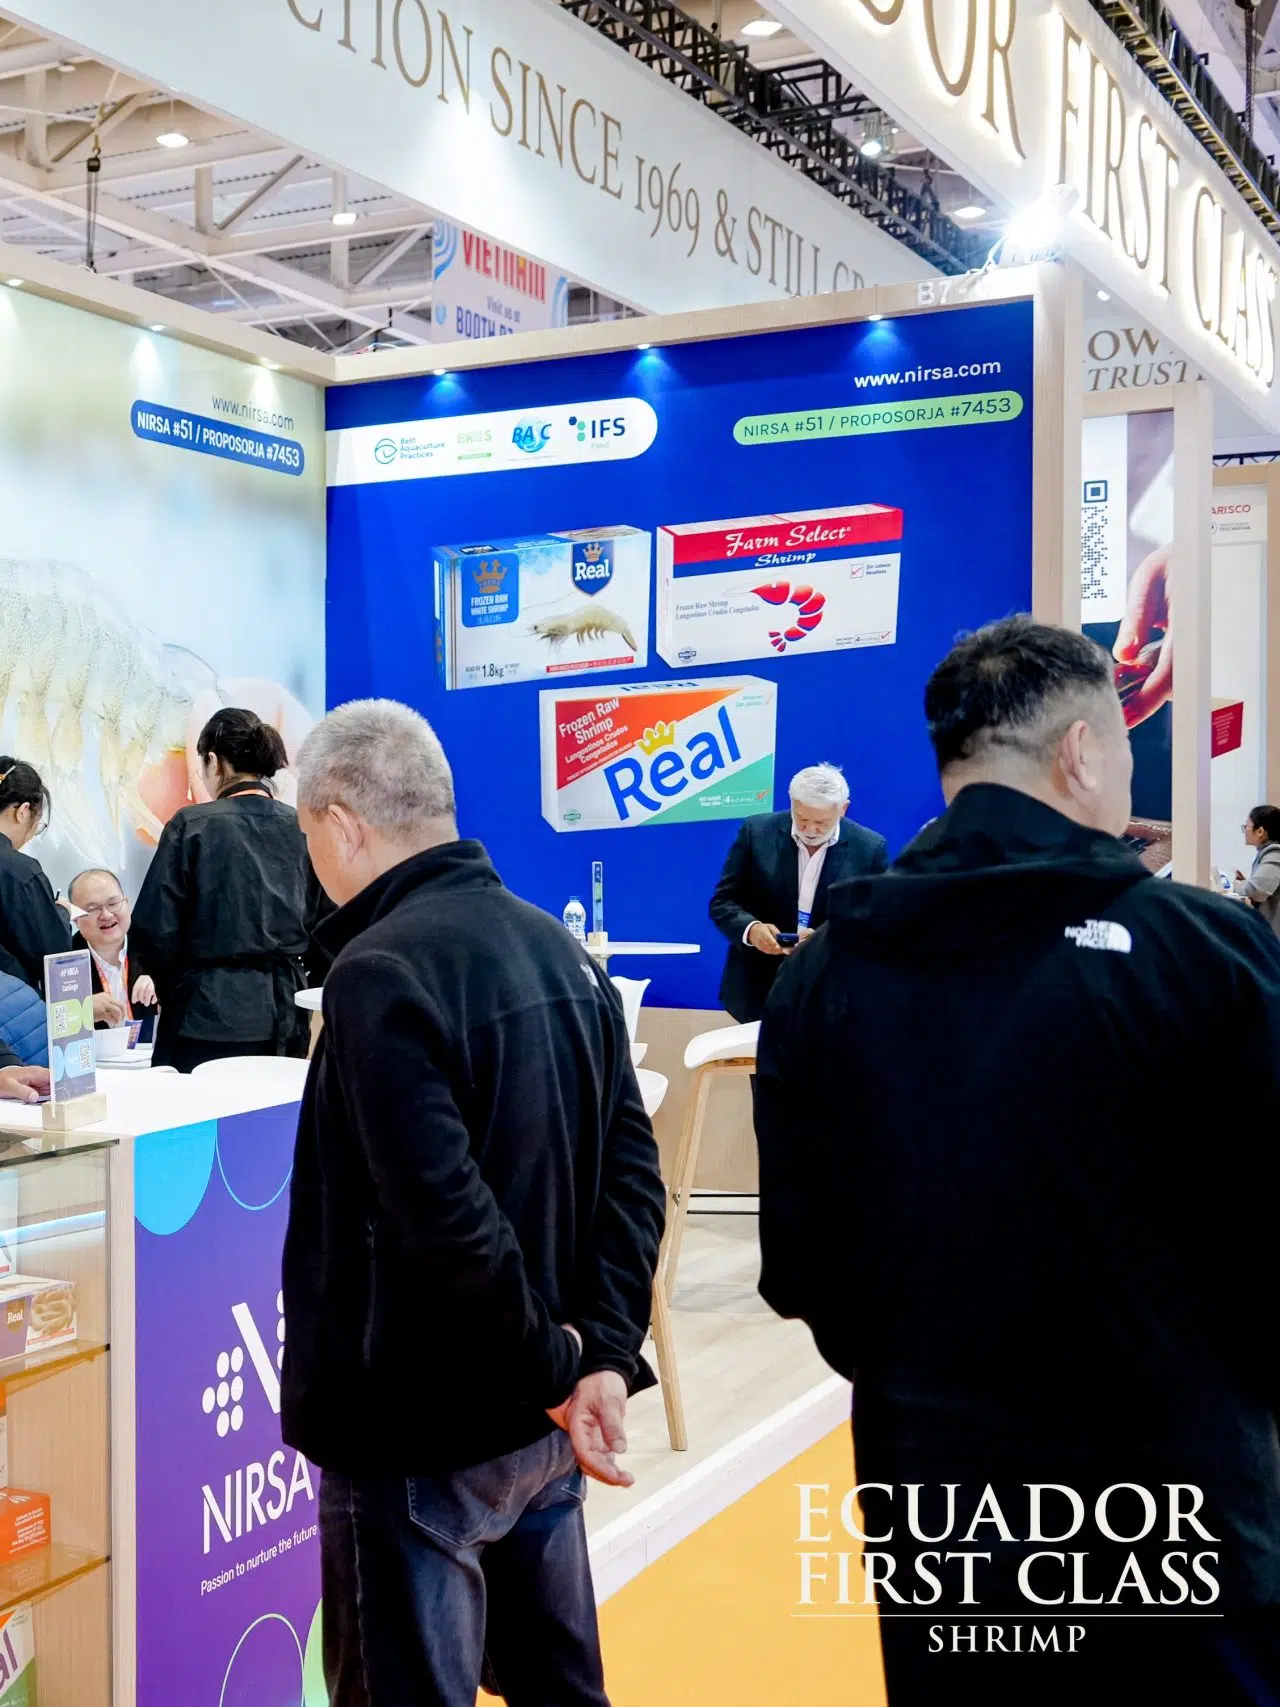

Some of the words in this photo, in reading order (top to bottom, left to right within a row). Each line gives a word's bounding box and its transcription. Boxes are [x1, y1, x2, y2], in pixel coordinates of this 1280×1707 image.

[490, 47, 624, 200] SINCE
[634, 155, 700, 258] 1969
[713, 188, 738, 265] &
[860, 0, 1026, 159] OR
[1053, 12, 1180, 294] FIRST
[854, 361, 1001, 388] www.nirsa.com
[1088, 360, 1207, 391] TRUST
[211, 395, 294, 431] www.nirsa.com
[591, 417, 626, 438] IFS
[744, 420, 789, 437] NIRSA
[794, 416, 823, 432] #51
[828, 415, 835, 431] /
[840, 407, 945, 428] PROPOSORJA
[950, 398, 1012, 417] #7453
[137, 411, 170, 435] NIRSA
[172, 419, 193, 440] #51
[195, 424, 201, 444] /
[202, 427, 265, 460] PROPOSORJA
[266, 442, 300, 468] #7453
[400, 437, 416, 445] Best
[400, 442, 446, 452] Aquaculture
[725, 532, 779, 556] Farm
[785, 525, 847, 546] Select
[574, 561, 610, 581] Real
[754, 552, 817, 567] Shrimp
[559, 711, 596, 738] Frozen
[595, 696, 620, 717] Raw
[574, 717, 613, 744] Shrimp
[604, 725, 629, 742] Crudos
[603, 704, 742, 822] Real
[7, 1309, 24, 1324] Real
[201, 1450, 314, 1554] NIRSA
[200, 1569, 234, 1596] Passion
[236, 1563, 245, 1577] to
[246, 1547, 277, 1572] nurture
[278, 1538, 292, 1555] the
[293, 1524, 318, 1548] future
